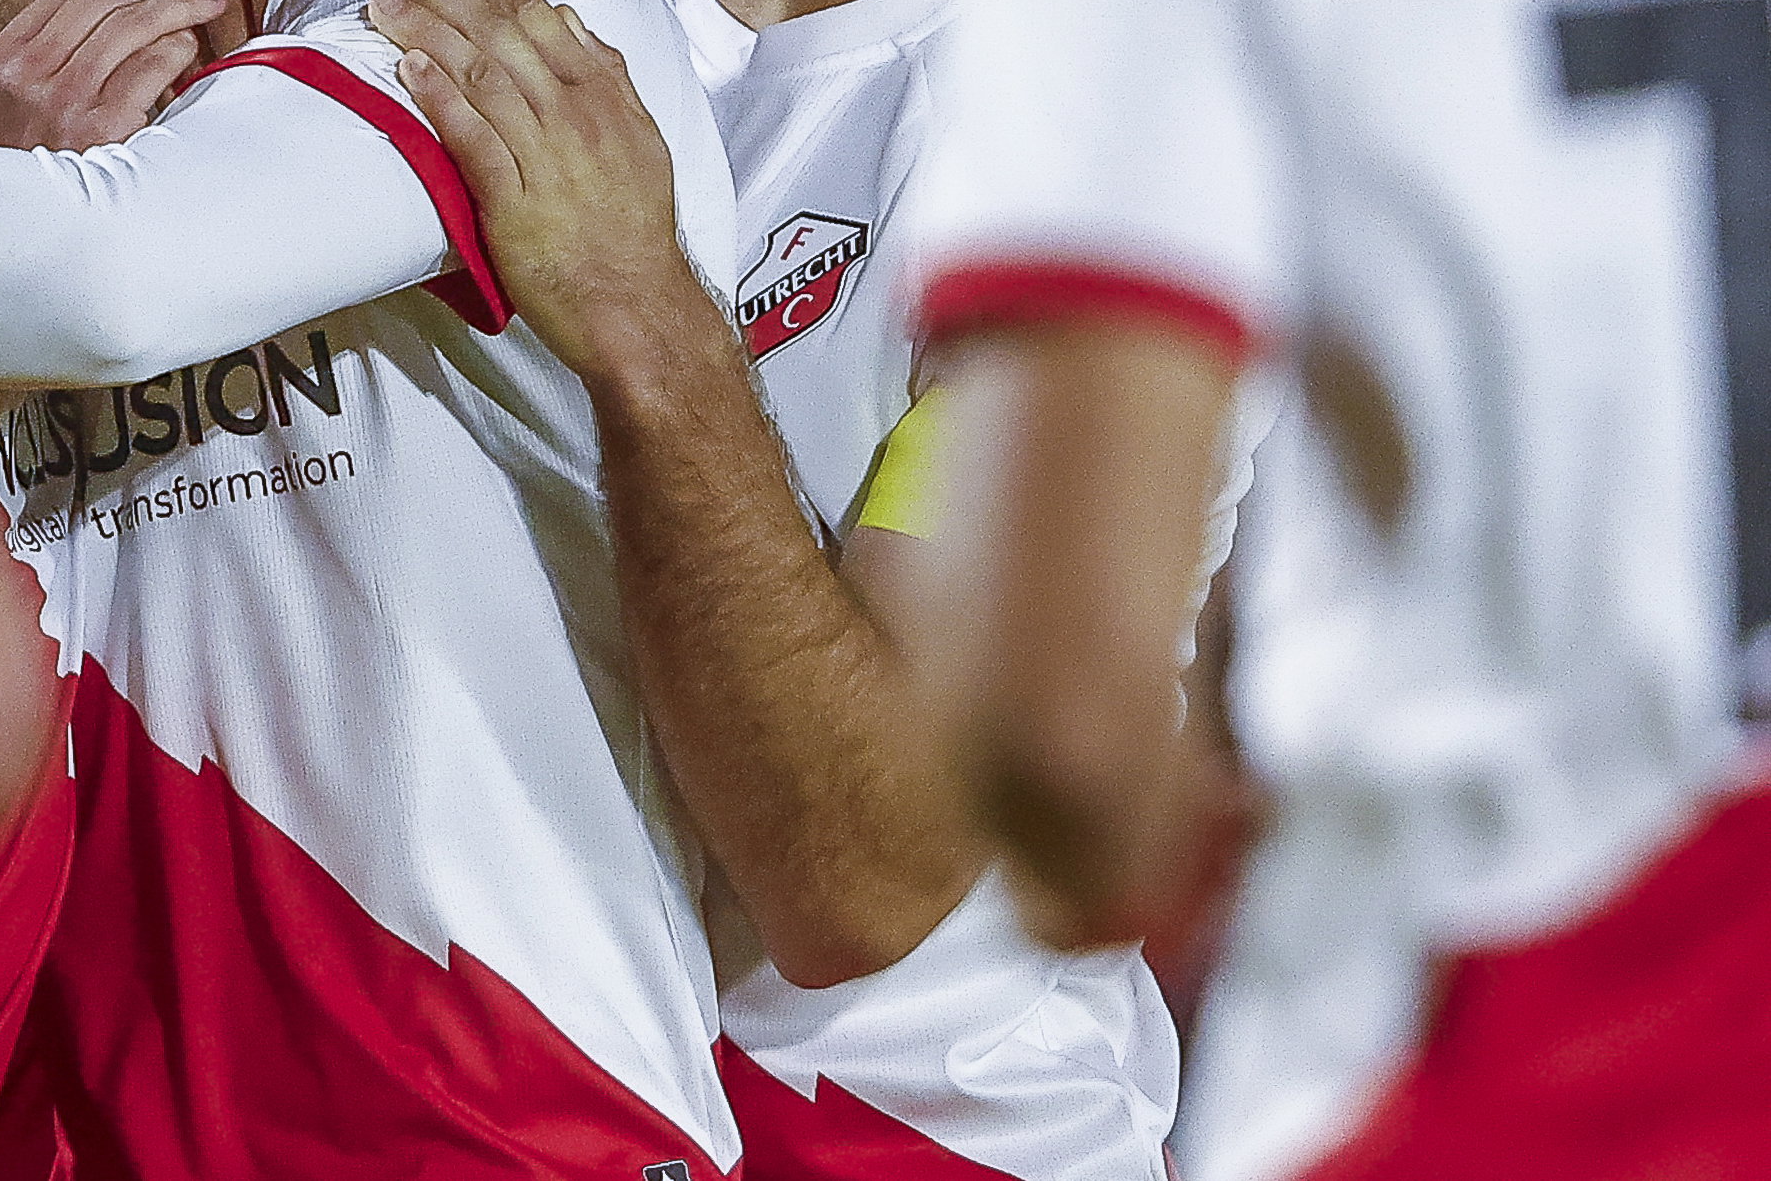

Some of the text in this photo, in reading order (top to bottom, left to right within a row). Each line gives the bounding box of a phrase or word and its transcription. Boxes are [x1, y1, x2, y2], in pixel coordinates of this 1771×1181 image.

[779, 225, 815, 261] F
[739, 232, 862, 326] UTRECHT
[781, 292, 814, 329] C
[90, 450, 356, 540] transformation
